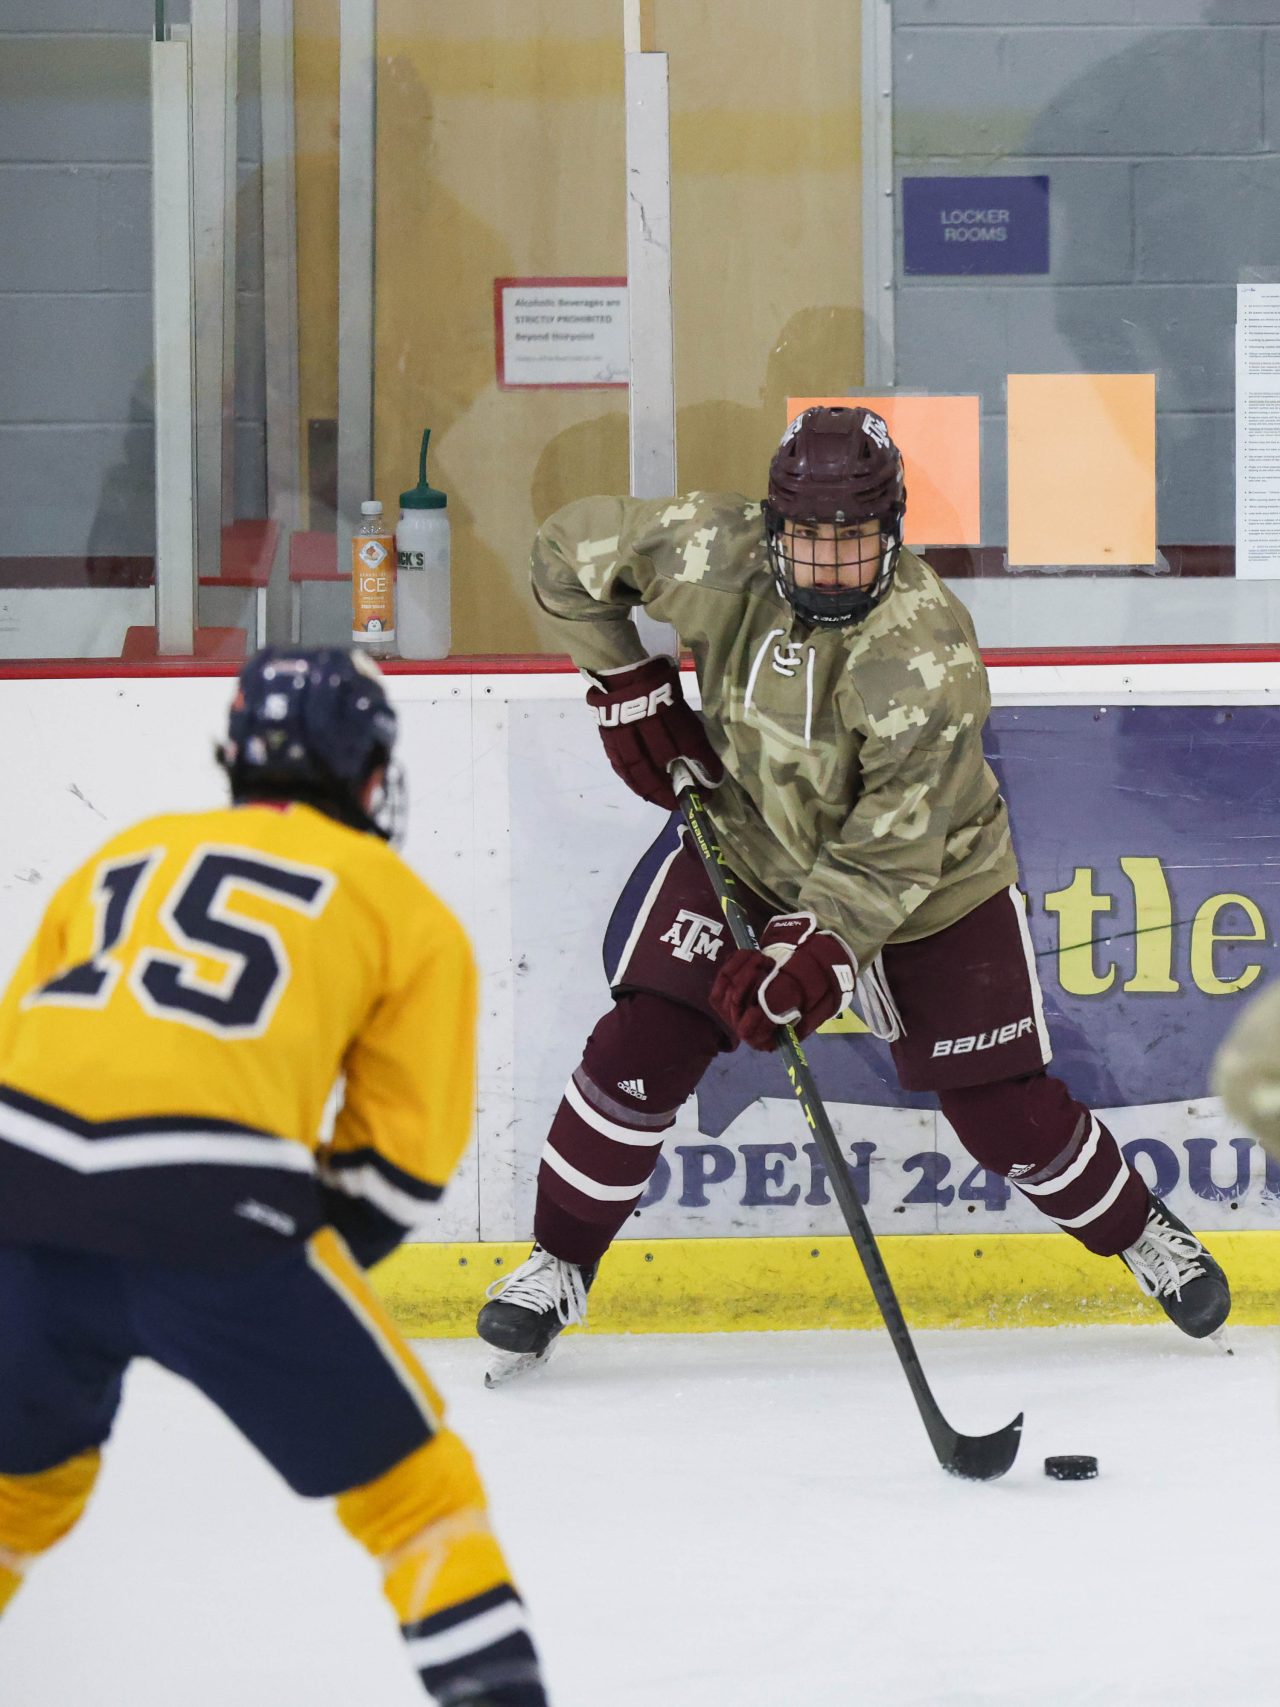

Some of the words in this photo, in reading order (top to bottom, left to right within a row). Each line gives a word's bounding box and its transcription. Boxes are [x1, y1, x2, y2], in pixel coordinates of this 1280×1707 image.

[940, 209, 1010, 225] LOCKER
[943, 226, 1008, 242] ROOMS
[557, 314, 613, 325] PROHIBITED
[360, 577, 386, 592] ICE
[594, 681, 675, 728] UER
[1022, 856, 1267, 996] tle
[22, 846, 338, 1041] 15
[930, 1015, 1036, 1059] BAUER
[617, 1082, 647, 1101] adidas
[902, 1151, 1011, 1211] 24
